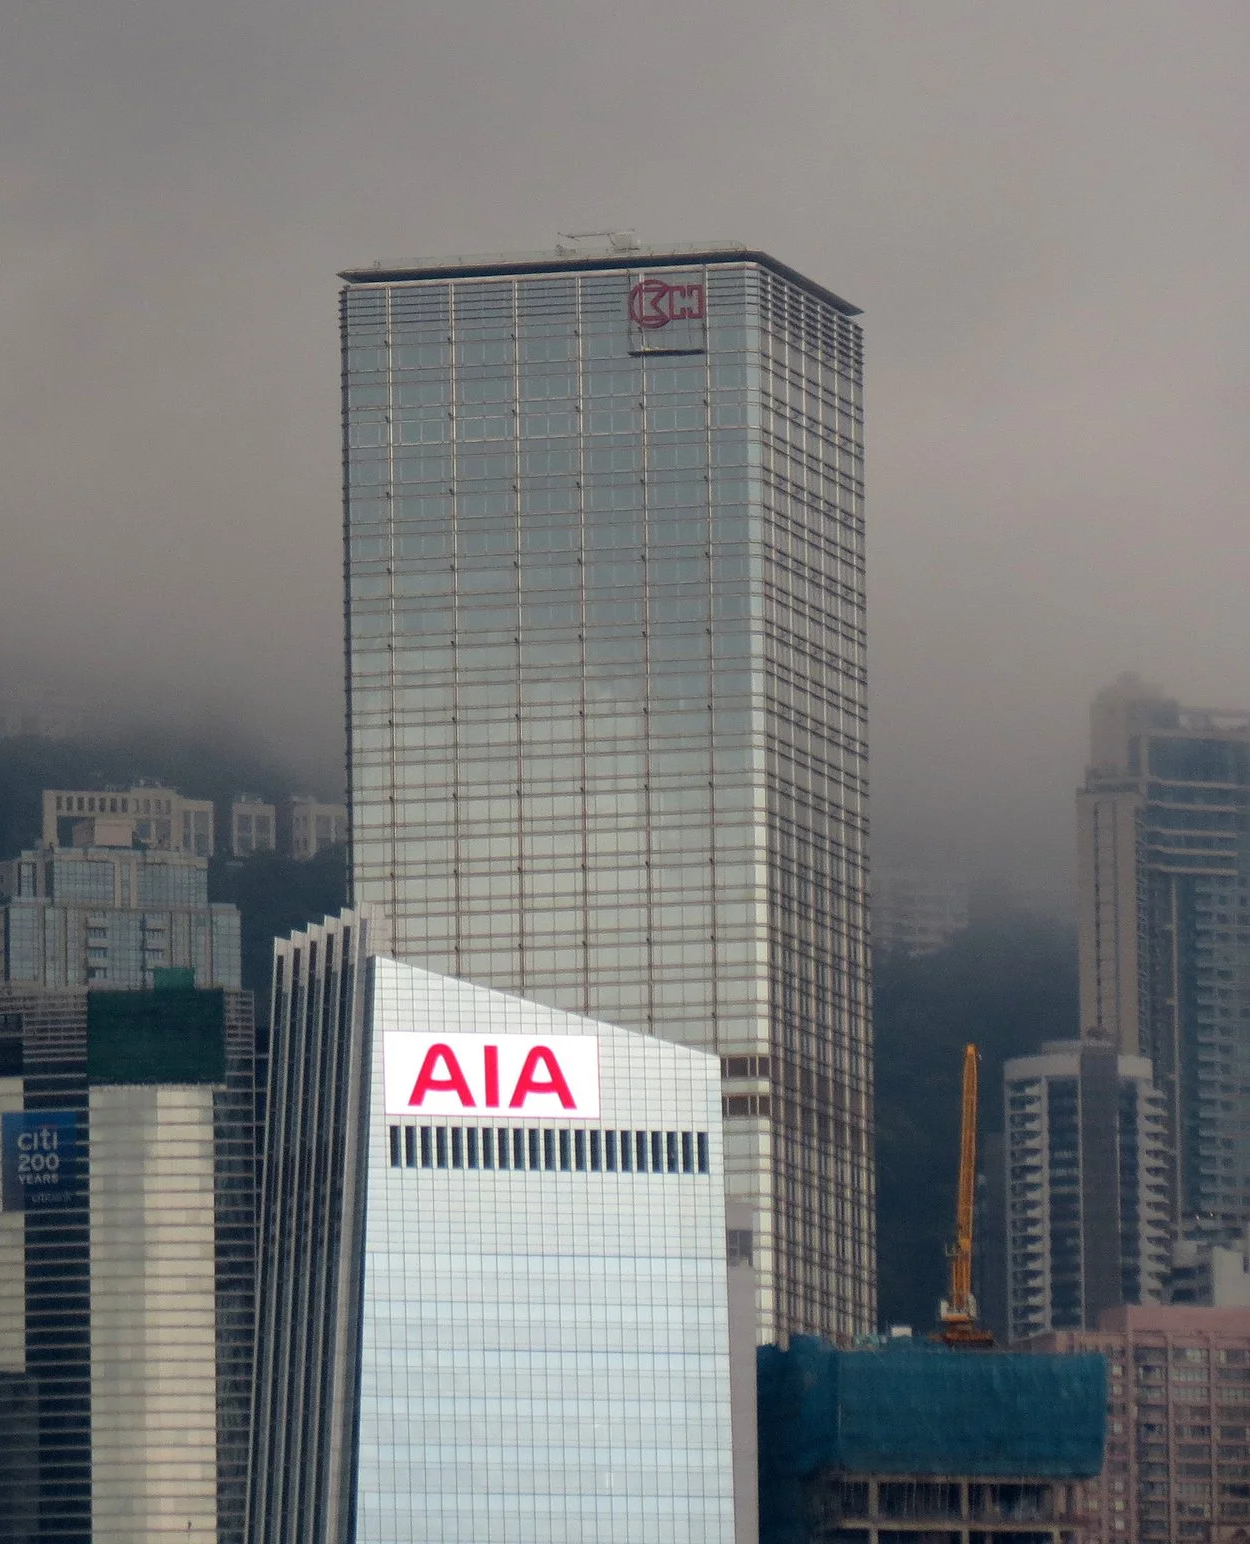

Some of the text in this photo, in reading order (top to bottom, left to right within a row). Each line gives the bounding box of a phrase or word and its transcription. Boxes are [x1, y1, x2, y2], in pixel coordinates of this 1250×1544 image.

[407, 1043, 578, 1110] AIA
[17, 1128, 58, 1151] citi
[17, 1153, 60, 1172] 200
[18, 1173, 60, 1185] YEARS
